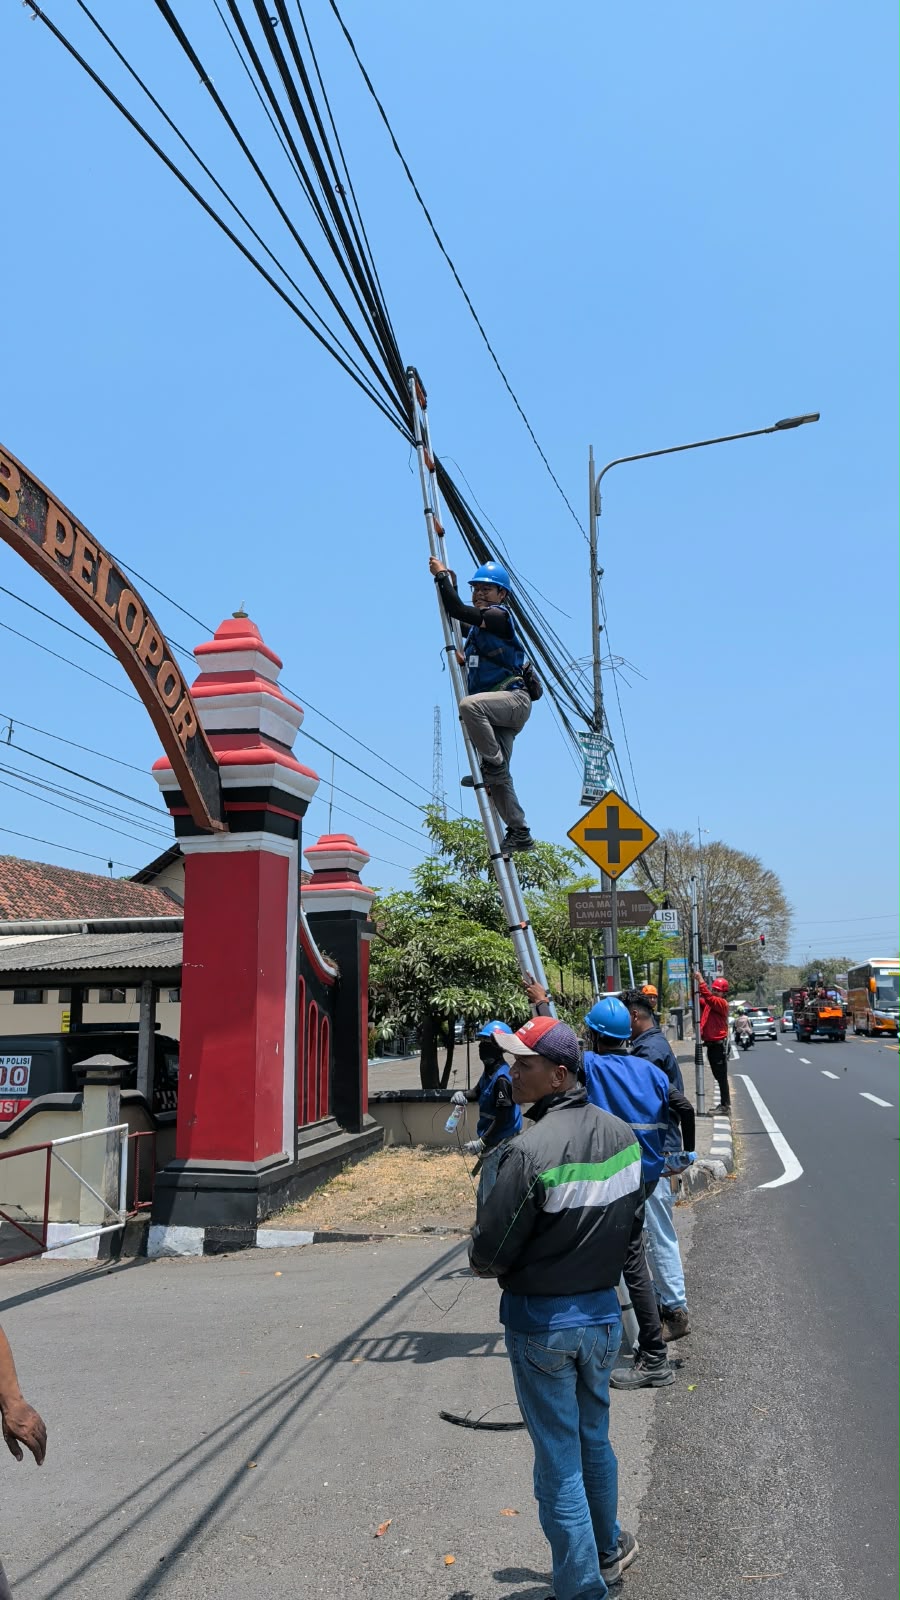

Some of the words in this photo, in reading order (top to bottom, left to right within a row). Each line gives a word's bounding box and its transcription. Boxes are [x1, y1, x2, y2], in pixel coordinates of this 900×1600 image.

[42, 497, 198, 751] PELOPOR
[575, 901, 595, 909] GOA
[596, 899, 626, 908] MAIA
[575, 909, 628, 919] LAWANGIH
[652, 911, 675, 921] LISI
[6, 1057, 30, 1065] POLISI
